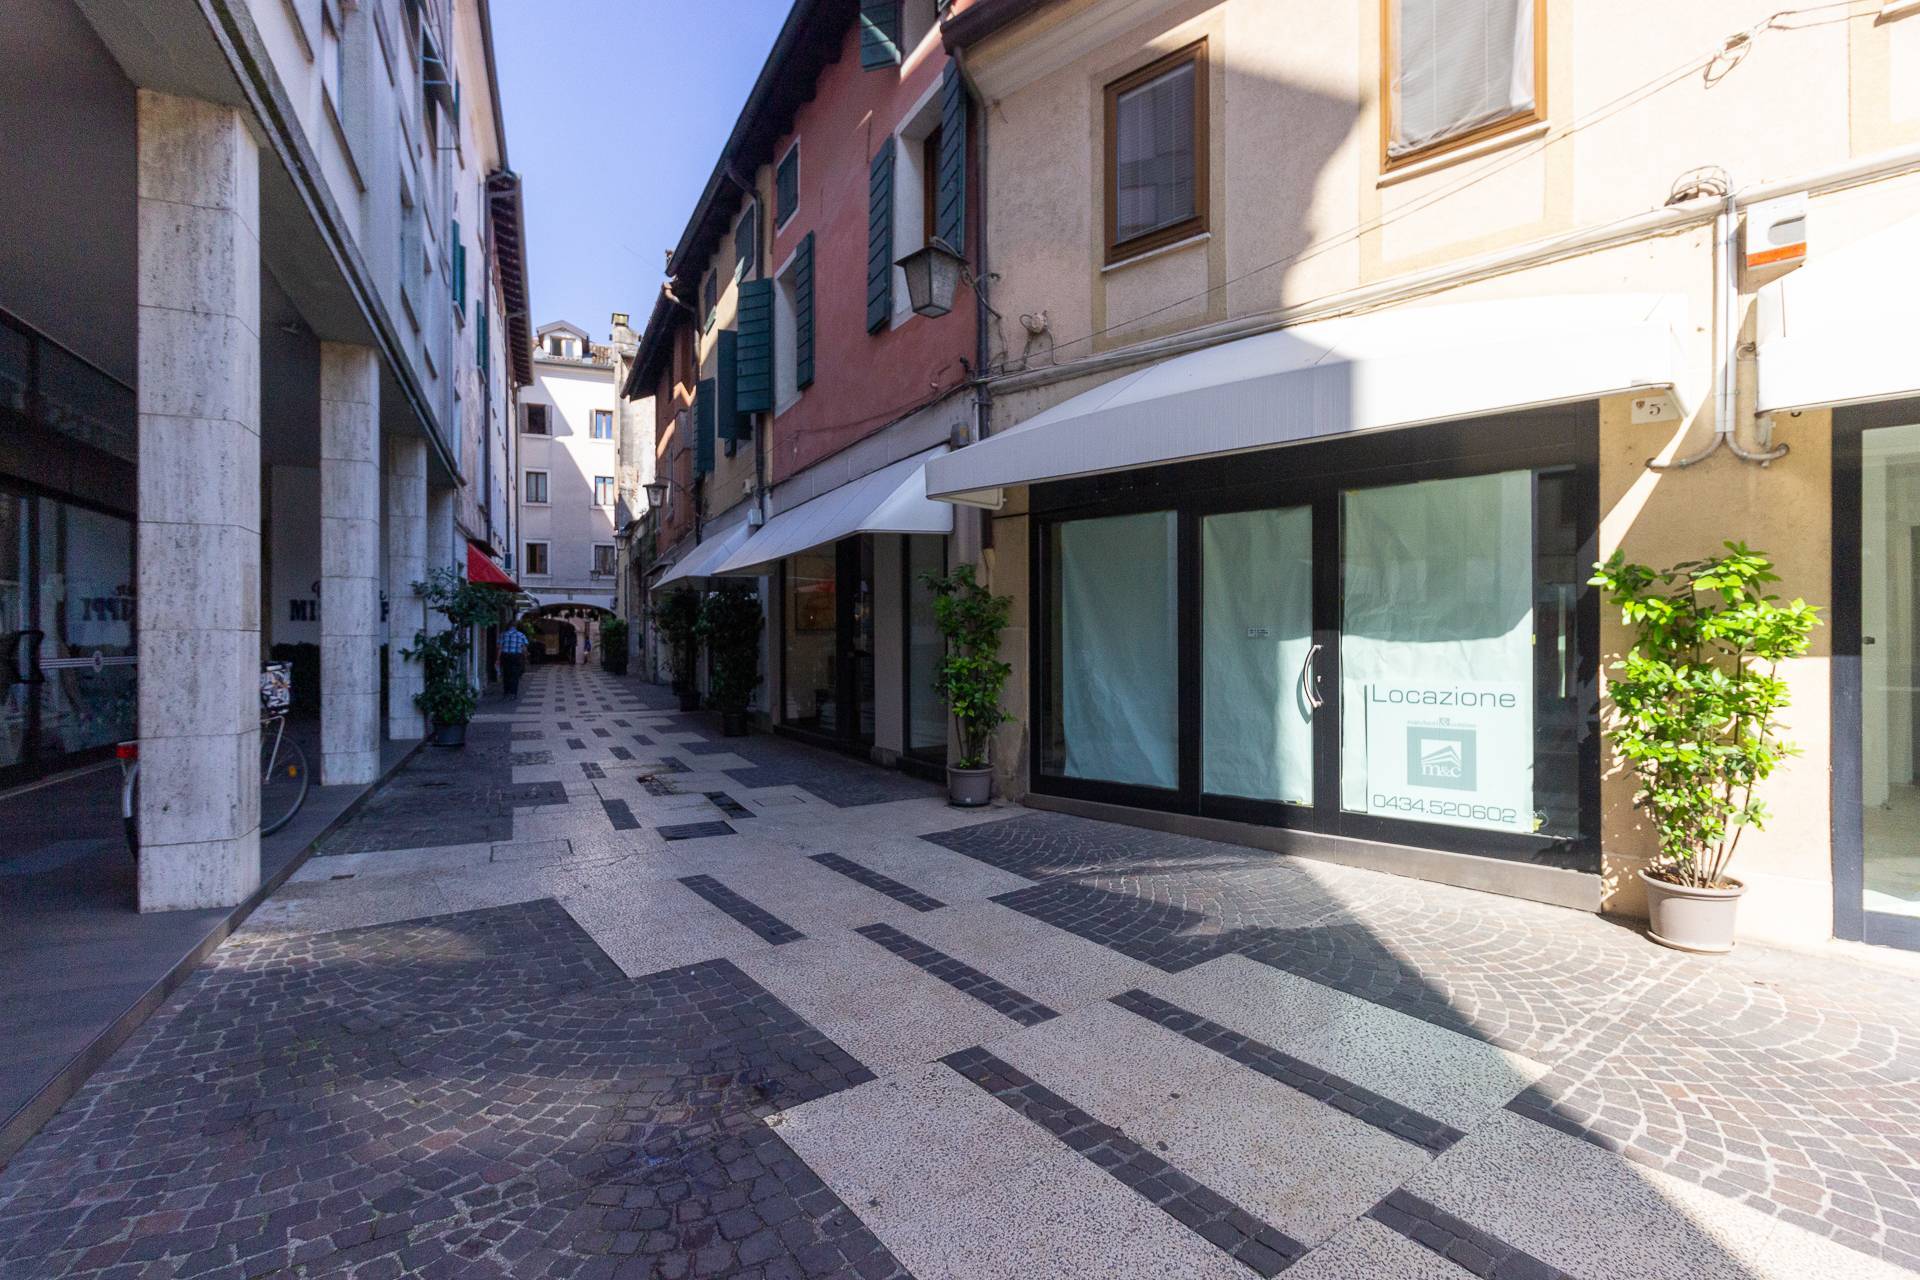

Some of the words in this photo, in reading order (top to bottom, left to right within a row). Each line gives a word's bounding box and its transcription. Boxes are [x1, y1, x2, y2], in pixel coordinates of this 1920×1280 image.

[1649, 403, 1662, 416] 5
[1372, 683, 1516, 708] Locazione
[1373, 794, 1517, 824] 0434.520602
